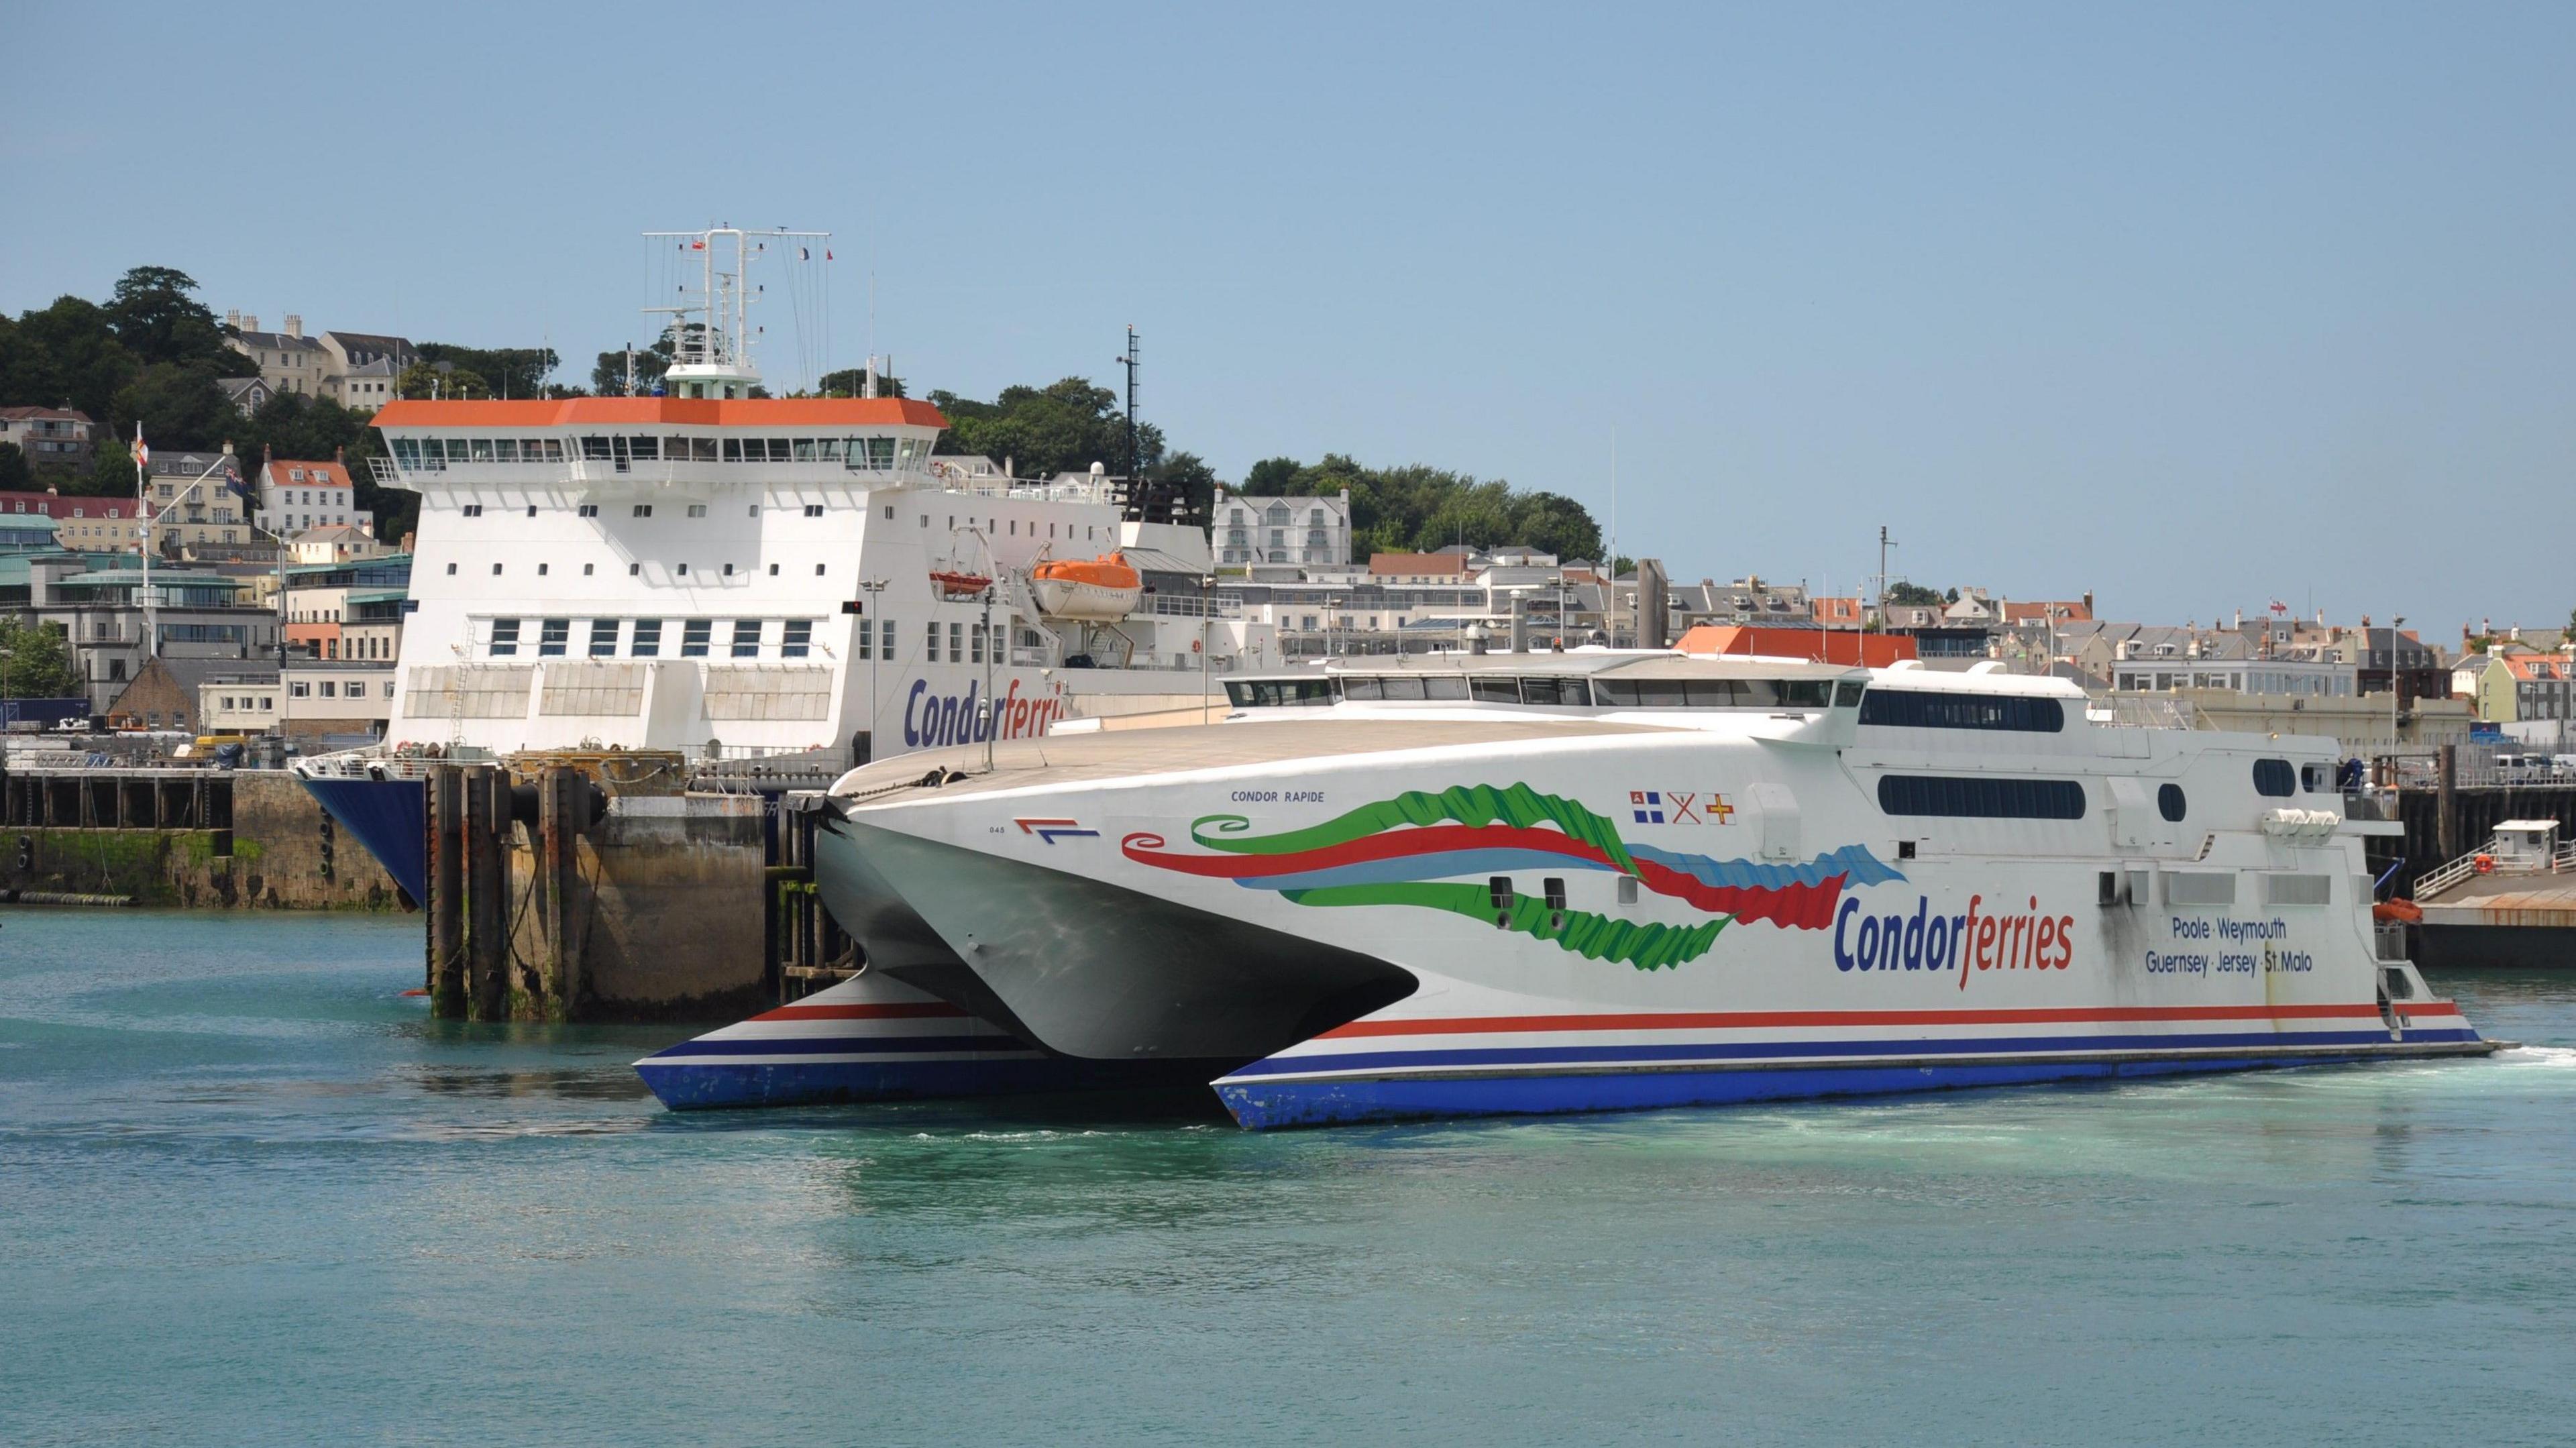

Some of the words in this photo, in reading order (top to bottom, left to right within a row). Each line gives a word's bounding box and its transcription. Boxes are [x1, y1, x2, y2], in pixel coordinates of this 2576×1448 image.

[904, 679, 1064, 747] Condorferri
[1232, 791, 1279, 803] CONDOR
[1285, 792, 1326, 803] RAPIDE
[1834, 895, 2075, 992] Condorferries
[2173, 917, 2210, 940] Poole
[2217, 917, 2288, 946] Weymouth
[2146, 950, 2209, 979] Guernsey
[2216, 950, 2257, 979] Jersey
